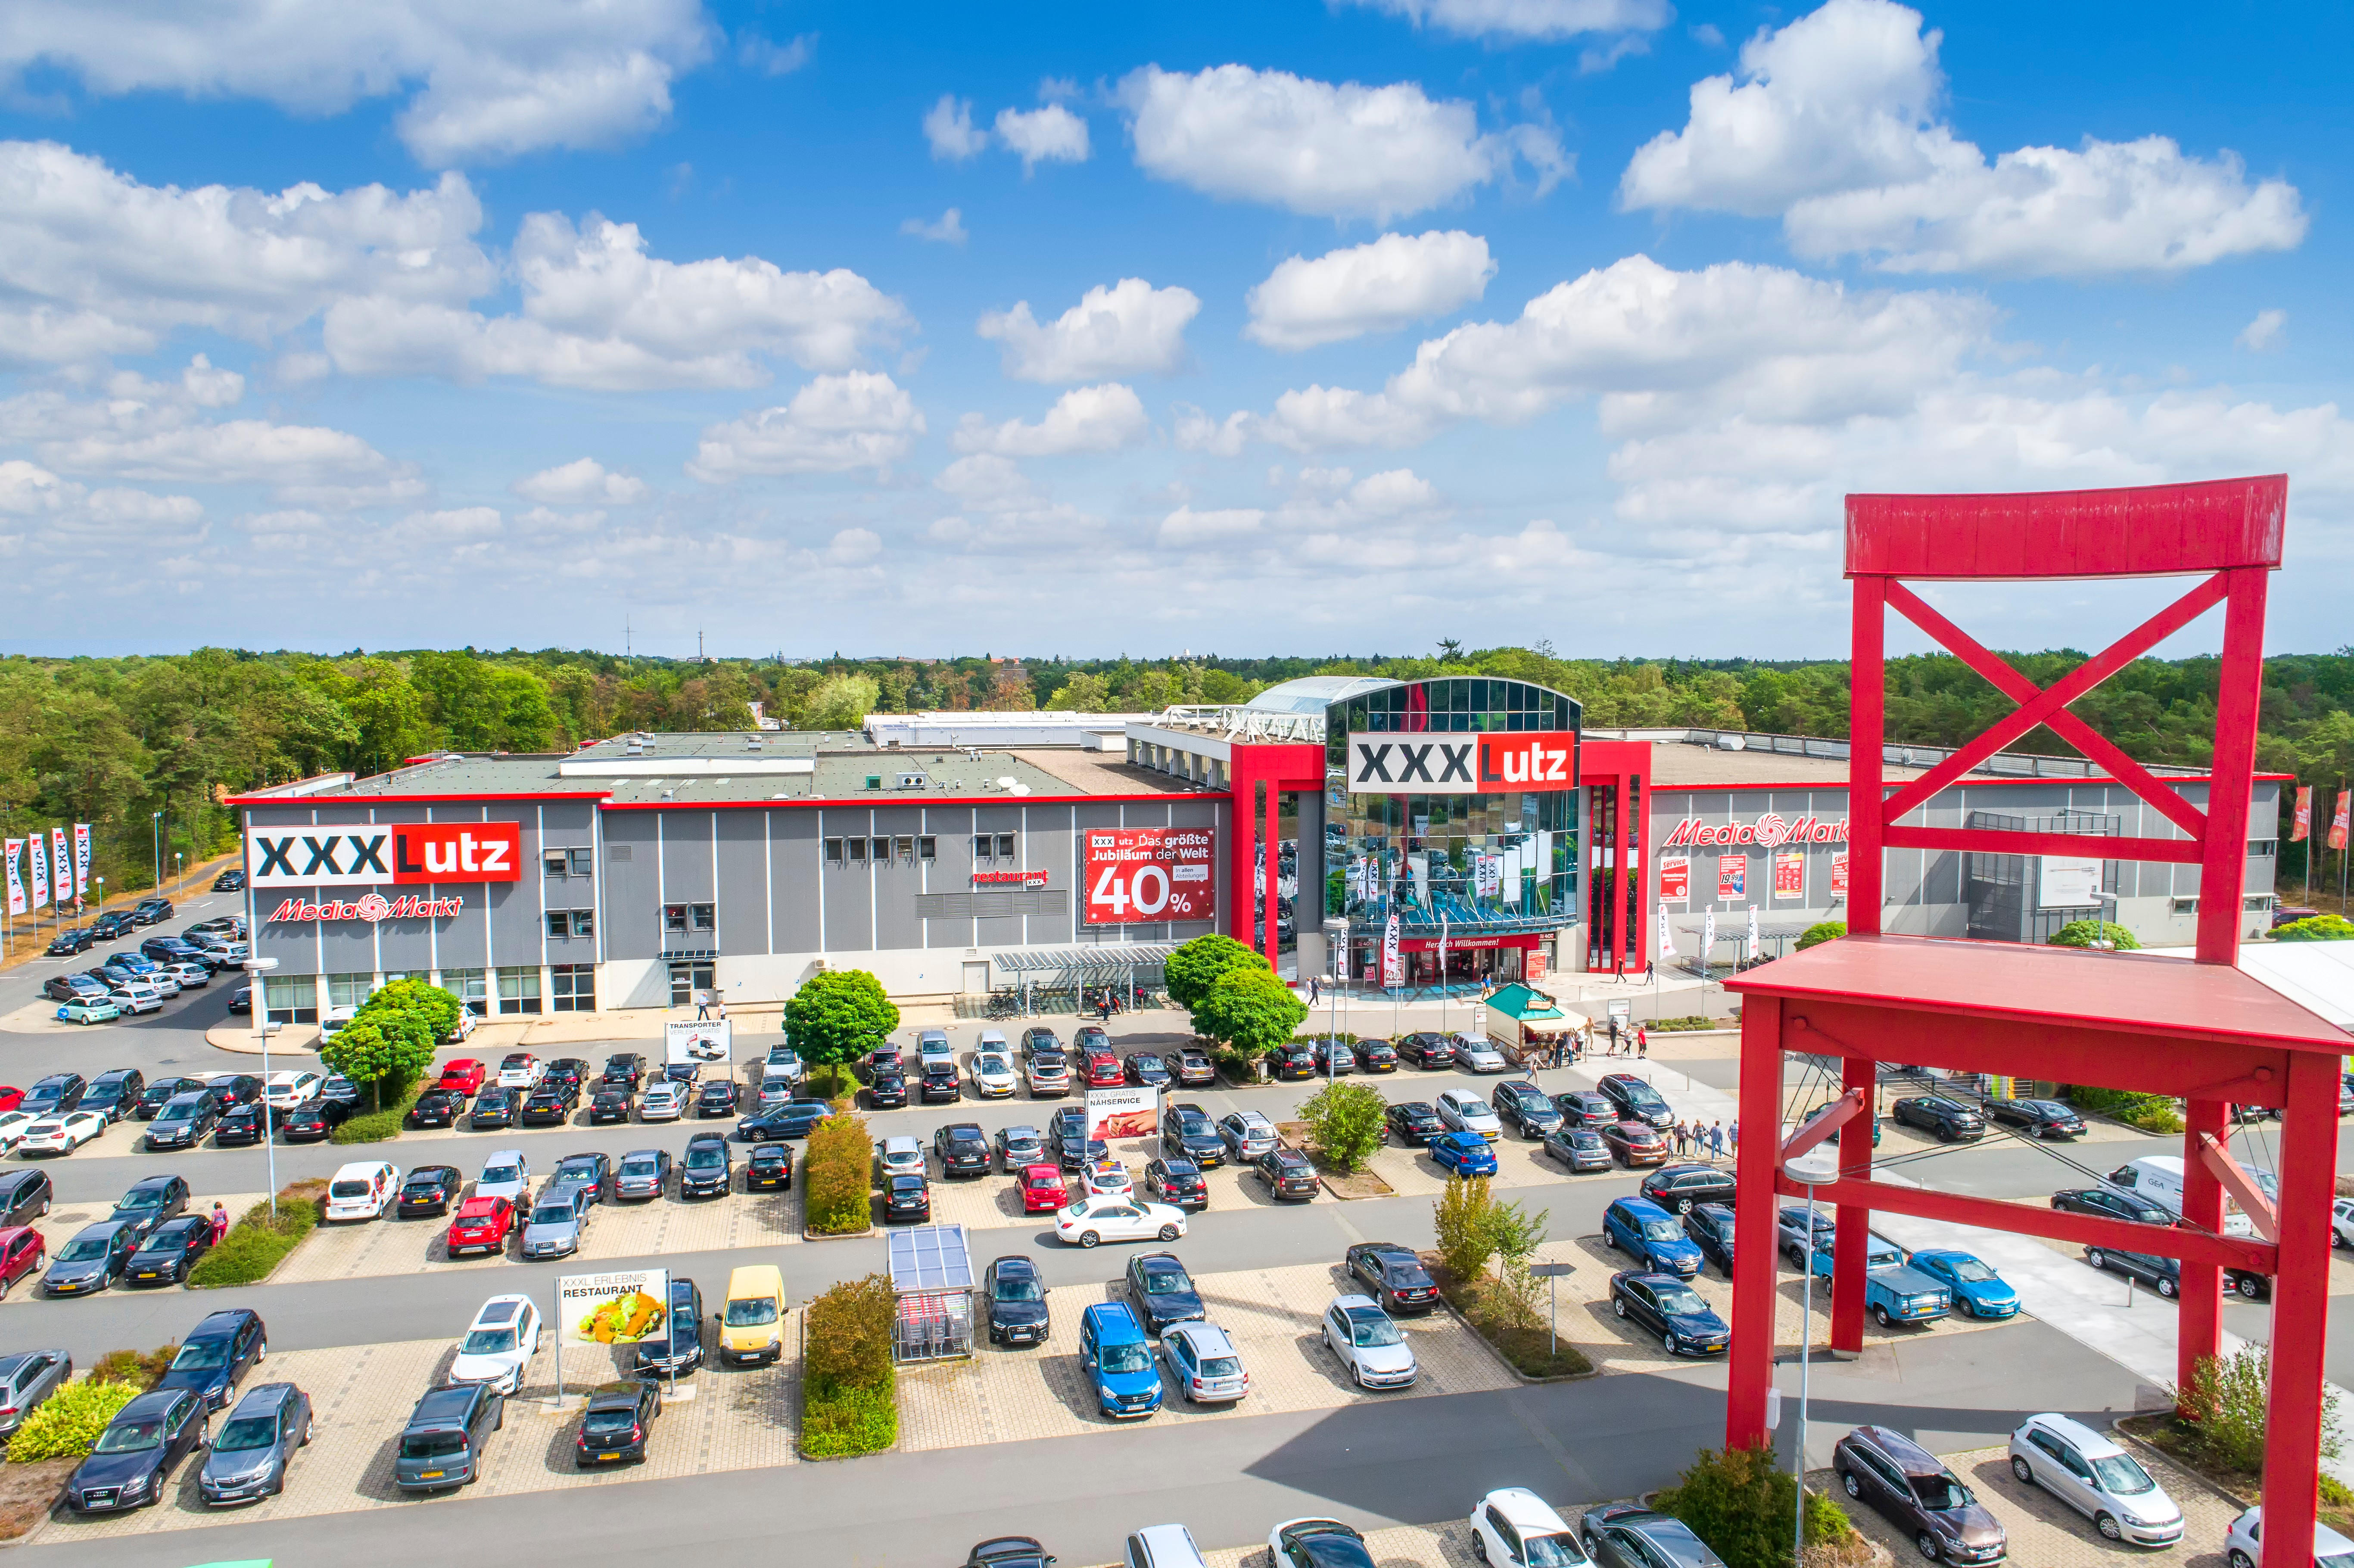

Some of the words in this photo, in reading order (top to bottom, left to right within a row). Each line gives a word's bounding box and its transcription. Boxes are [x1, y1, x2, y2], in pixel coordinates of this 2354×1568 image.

[1356, 742, 1566, 783] XXXLutz
[1664, 819, 1756, 845] Media
[1783, 818, 1849, 843] Mark
[1139, 836, 1161, 846] Das
[1165, 834, 1208, 848] größte
[256, 833, 510, 877] XXXLutz
[1092, 849, 1152, 861] Jubiläum
[1156, 849, 1177, 860] der
[1180, 847, 1208, 859] Welt
[1663, 859, 1686, 868] Service
[973, 869, 1049, 882] restaurant
[268, 898, 358, 922] Media
[385, 895, 463, 918] Markt
[1455, 938, 1499, 947] Willkommen!
[1090, 1097, 1141, 1106] NÄHSERVICE
[2148, 1178, 2164, 1189] GEA
[563, 1278, 590, 1287] XXXL
[595, 1273, 647, 1285] ERLEBNIS
[564, 1285, 643, 1298] RESTAURANT
